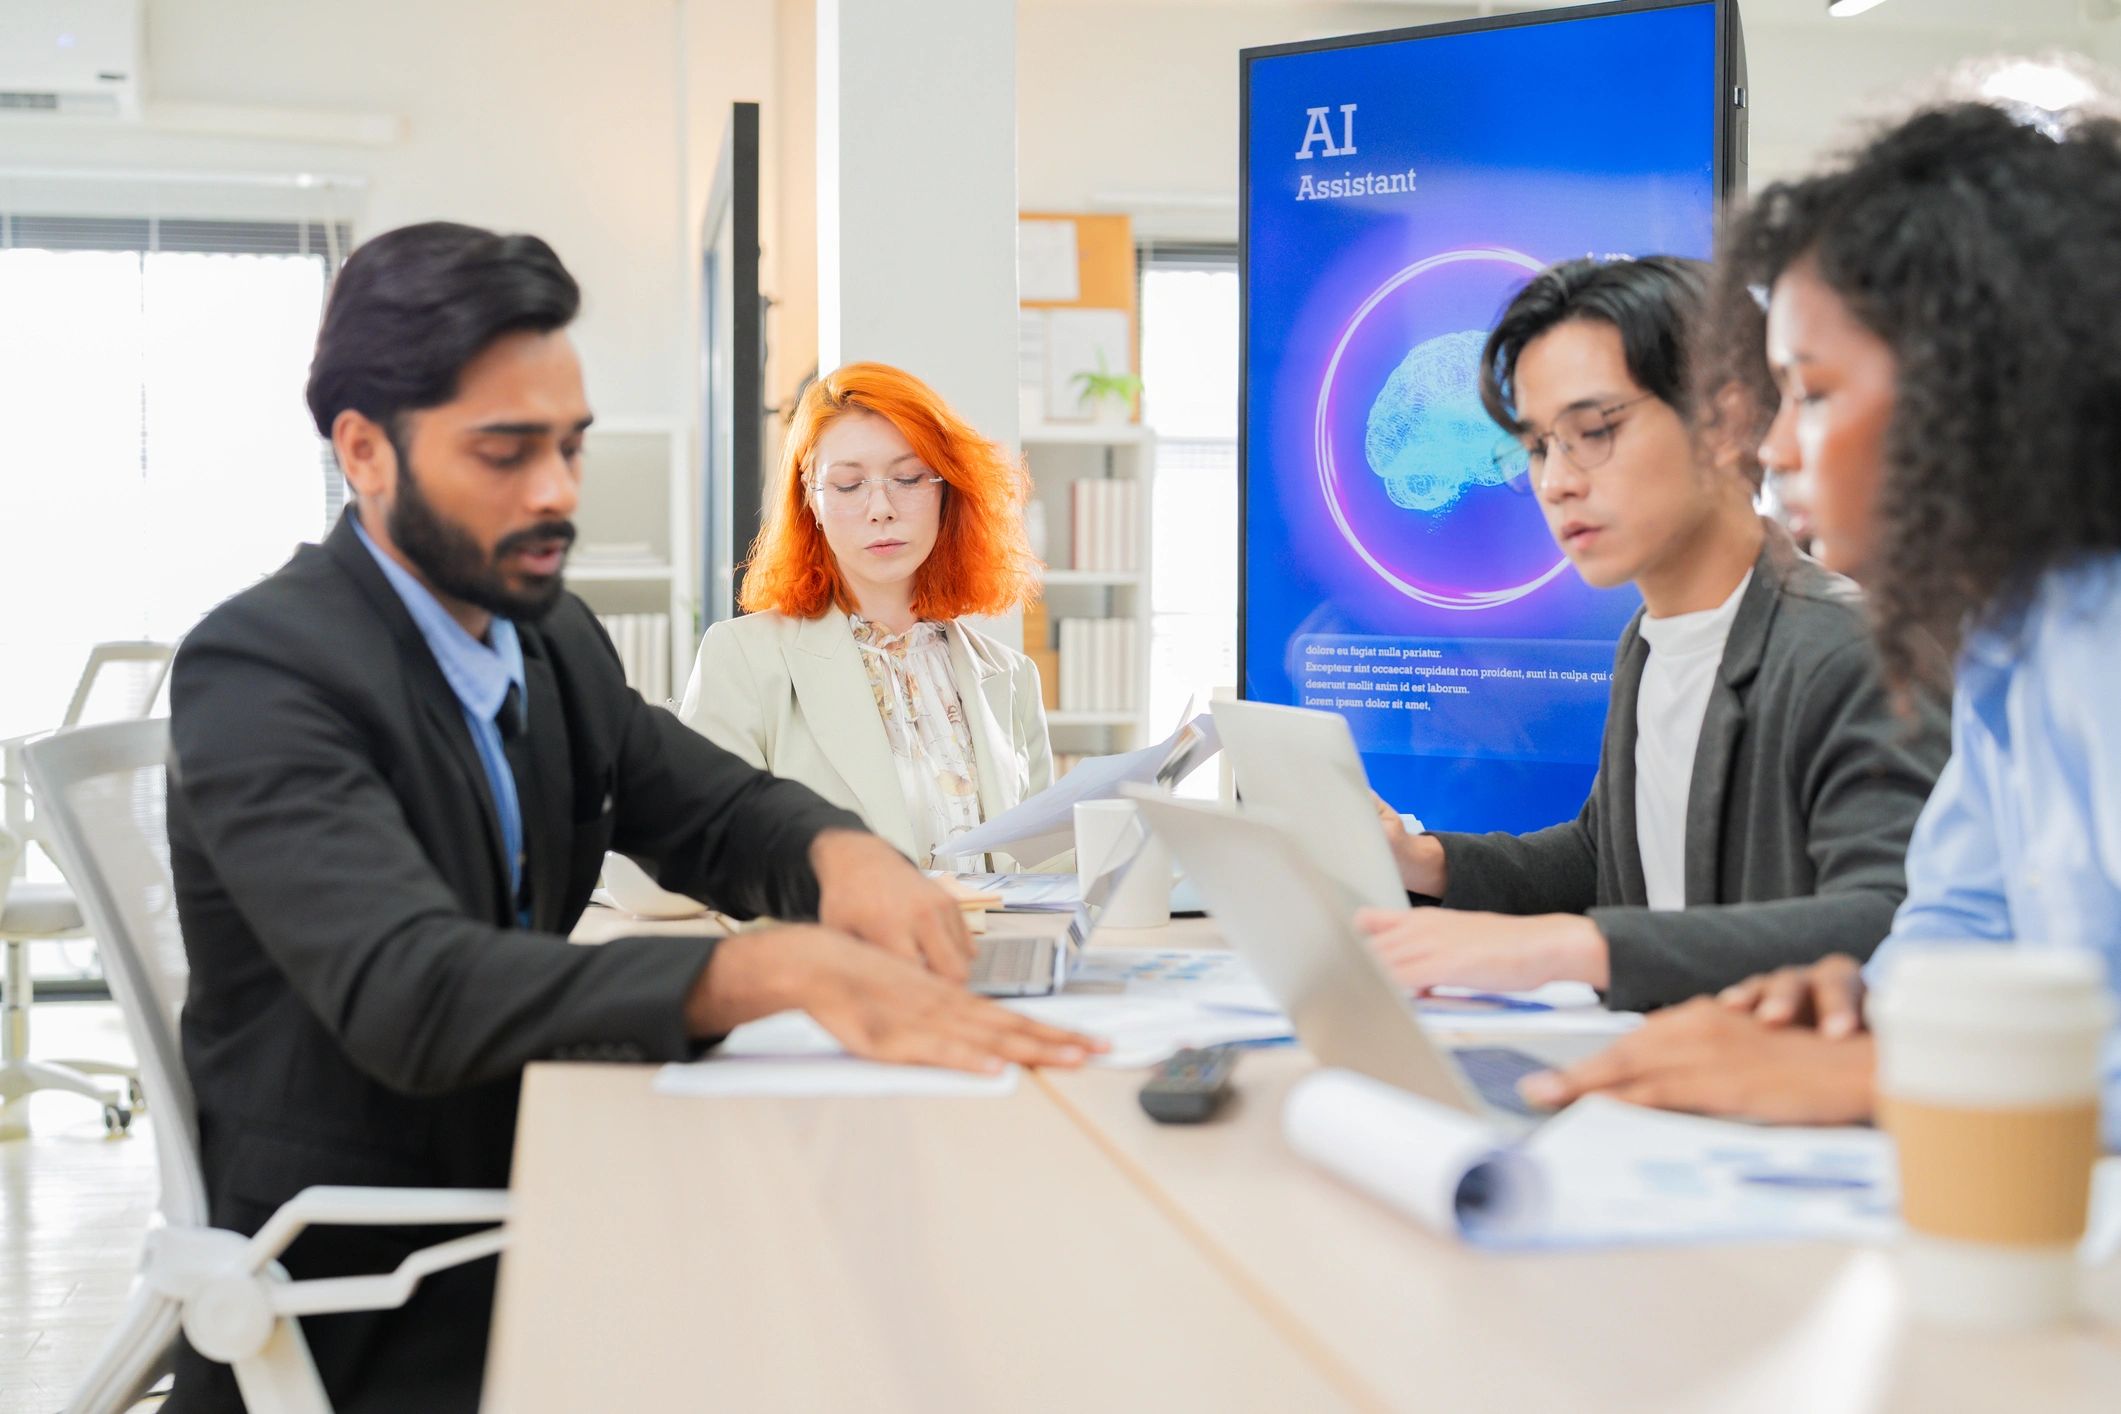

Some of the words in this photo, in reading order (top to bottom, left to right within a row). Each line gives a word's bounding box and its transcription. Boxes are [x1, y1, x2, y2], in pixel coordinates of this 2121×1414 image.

[1295, 103, 1357, 160] AI
[1295, 168, 1416, 201] Assistant
[1305, 645, 1335, 656] dolore
[1337, 648, 1349, 656] eu
[1351, 646, 1377, 659] fugiat
[1378, 647, 1401, 657] nulla
[1403, 648, 1443, 660] pariatur.
[1305, 662, 1352, 674] Excepteur
[1354, 663, 1371, 673] sint
[1372, 665, 1413, 675] occaecat
[1415, 666, 1459, 678] cupidatat
[1461, 669, 1479, 677] non
[1481, 668, 1525, 679] proident,
[1526, 670, 1547, 679] sunt
[1549, 669, 1559, 680] in
[1561, 671, 1588, 683] culpa
[1591, 673, 1607, 683] qui
[1305, 679, 1346, 690] deserunt
[1348, 681, 1374, 691] mollit
[1376, 683, 1399, 692] anim
[1400, 682, 1410, 692] id
[1412, 684, 1426, 693] est
[1428, 684, 1470, 694] laborum.
[1305, 696, 1334, 706] Lorem
[1336, 697, 1364, 708] ipsum
[1366, 698, 1390, 709] dolor
[1392, 699, 1403, 709] sit
[1405, 701, 1431, 711] amet,
